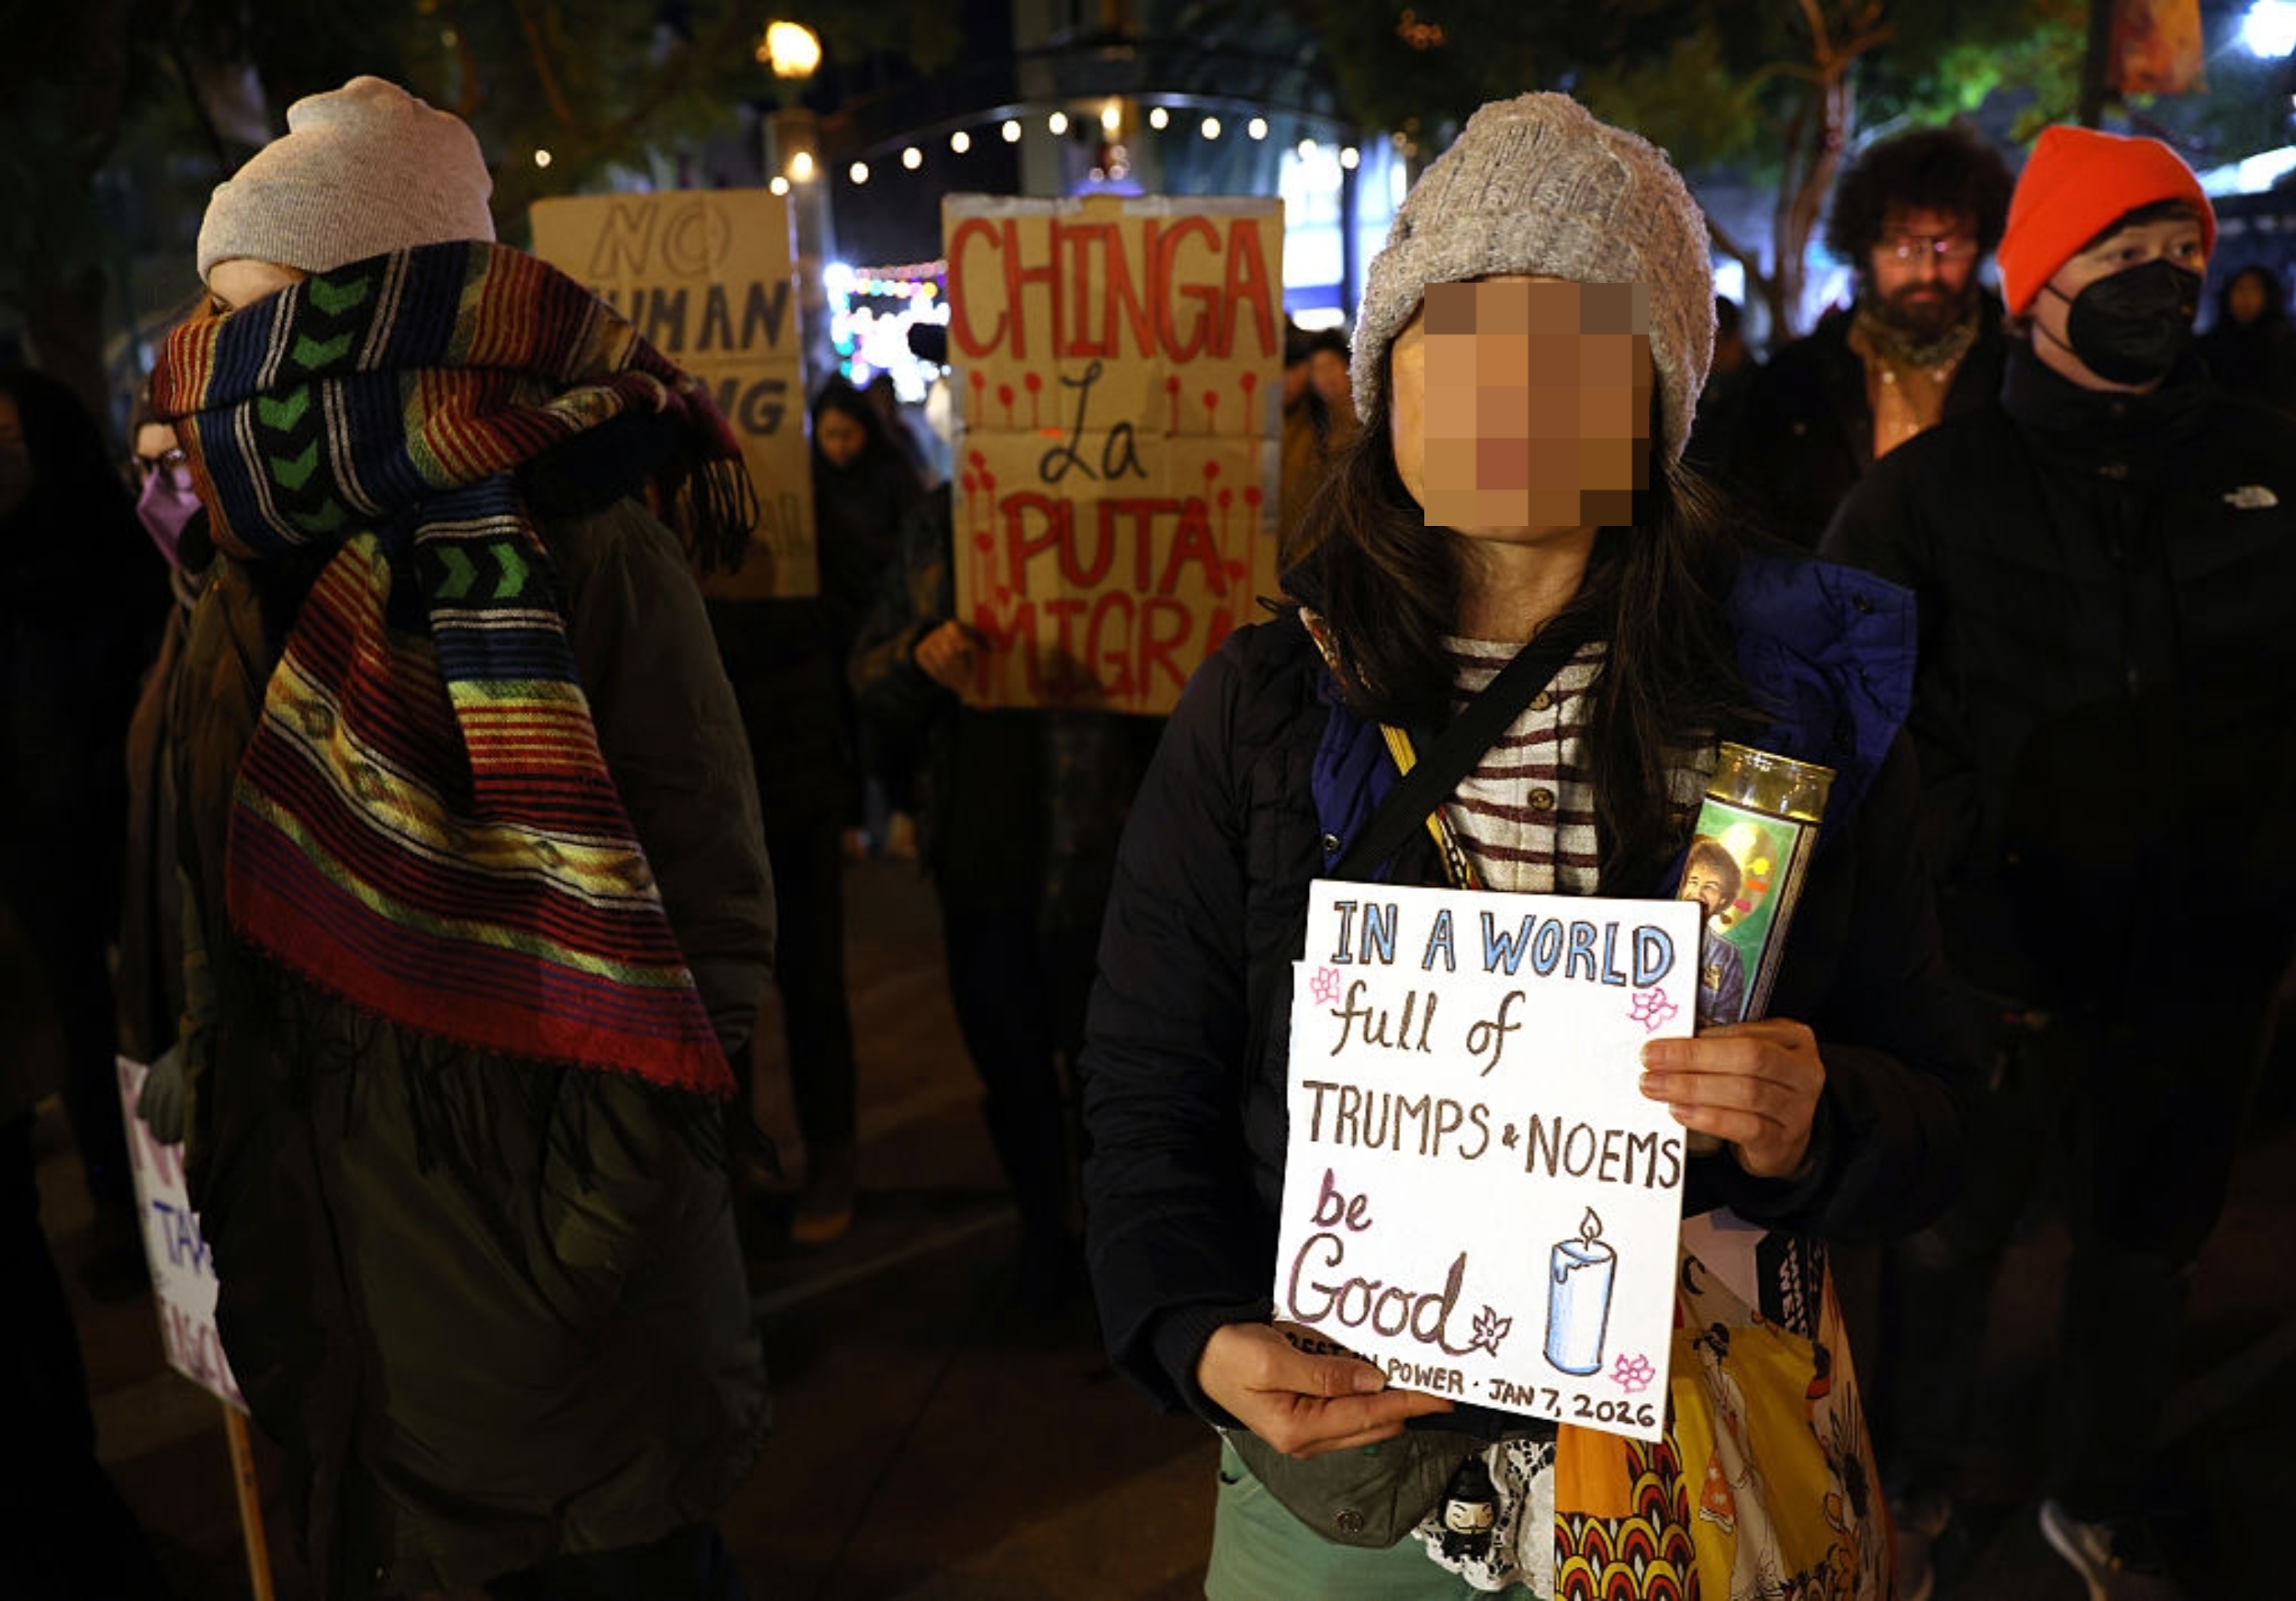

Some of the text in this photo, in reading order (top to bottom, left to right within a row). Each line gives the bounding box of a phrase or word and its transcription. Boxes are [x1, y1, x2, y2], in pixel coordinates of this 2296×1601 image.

[588, 201, 733, 278] NO
[594, 281, 790, 352] MAN
[949, 218, 1278, 363] CHINGA
[1041, 362, 1147, 484] La
[998, 492, 1226, 598] PUTA
[1331, 900, 1676, 989] IN A WORLD
[1331, 980, 1527, 1077] full of
[1303, 1080, 1681, 1190] TRUMPS & NOEMS
[1310, 1167, 1373, 1231] be
[1287, 1232, 1476, 1357] Good
[1387, 1358, 1464, 1395] POWER
[1488, 1378, 1535, 1406] JAN
[1540, 1387, 1561, 1418] 7,
[1573, 1394, 1656, 1427] 2026
